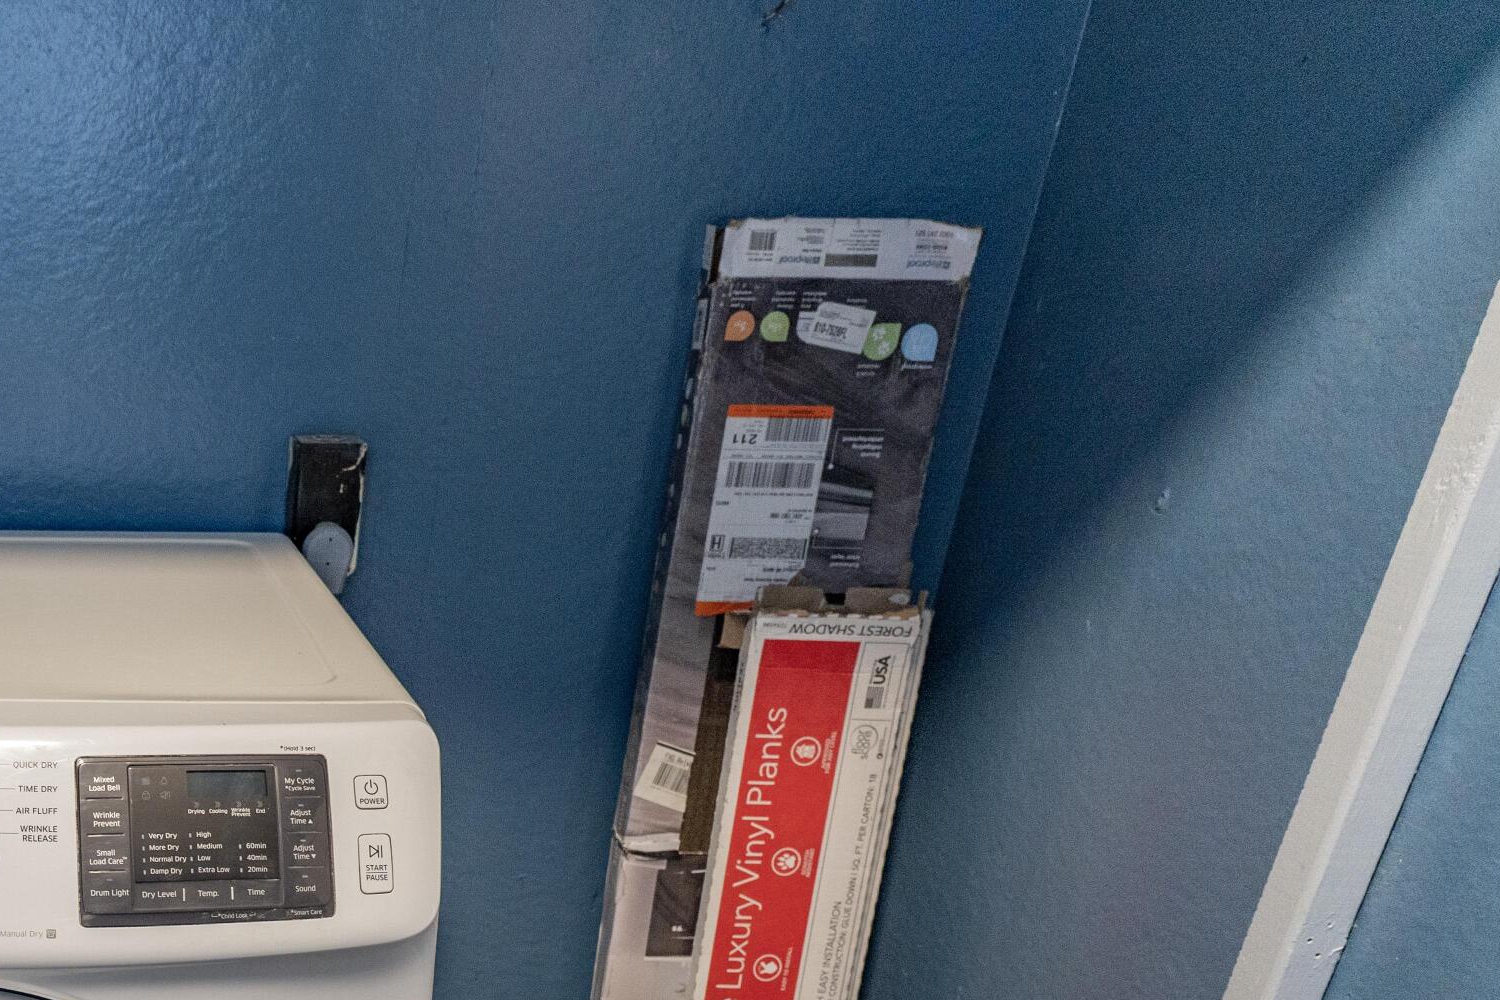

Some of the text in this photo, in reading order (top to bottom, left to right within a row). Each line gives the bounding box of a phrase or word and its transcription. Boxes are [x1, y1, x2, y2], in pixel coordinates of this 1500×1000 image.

[789, 621, 856, 636] SHADOW
[858, 622, 913, 638] FOREST
[874, 655, 891, 685] USA
[746, 707, 787, 806] Planks
[13, 761, 58, 769] QUICK DRY
[284, 777, 315, 785] My Cycle
[18, 785, 58, 793] TIME DRY
[88, 784, 120, 792] Load Bell
[15, 807, 58, 815] AIR FLUFF
[93, 811, 120, 819] Wrinkle
[290, 809, 311, 817] Adjust
[20, 825, 58, 833] WRINKLE
[165, 832, 178, 840] Dry
[196, 831, 211, 839] High
[166, 844, 179, 852] Dry
[293, 844, 315, 852] Adjust
[732, 815, 775, 888] Vinyl
[96, 849, 116, 857] Small
[89, 857, 107, 865] Load
[175, 855, 187, 864] Dry
[150, 867, 183, 876] Damp Dry
[90, 889, 130, 898] Drum Light
[142, 890, 177, 899] Dry Level
[197, 889, 219, 898] Temp.
[247, 888, 266, 896] Time
[846, 878, 856, 905] DOWN
[0, 930, 43, 939] Manual Dry
[822, 901, 842, 969] INSTALLATION
[716, 893, 762, 990] Luxury
[817, 971, 828, 999] EASY
